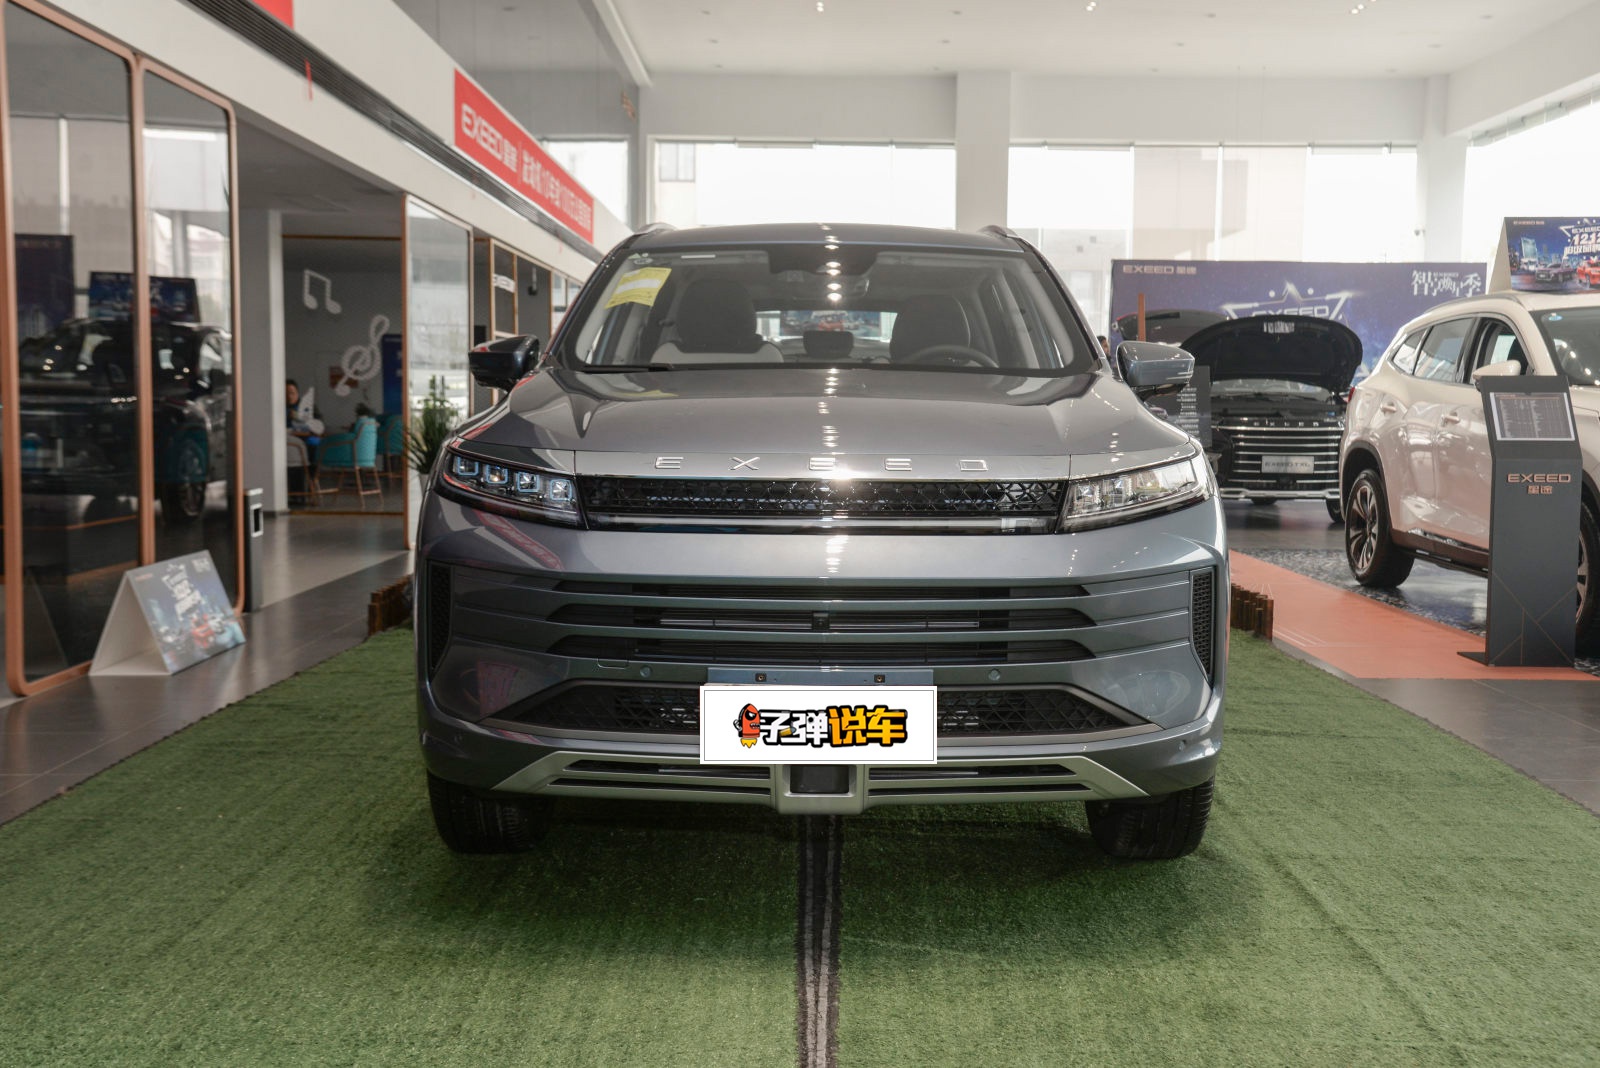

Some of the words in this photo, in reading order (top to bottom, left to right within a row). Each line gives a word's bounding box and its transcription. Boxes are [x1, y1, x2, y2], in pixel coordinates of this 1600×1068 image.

[461, 103, 503, 161] EXEED
[1122, 265, 1175, 274] EXEED
[655, 456, 989, 472] EXEED
[1507, 473, 1571, 483] EXEED
